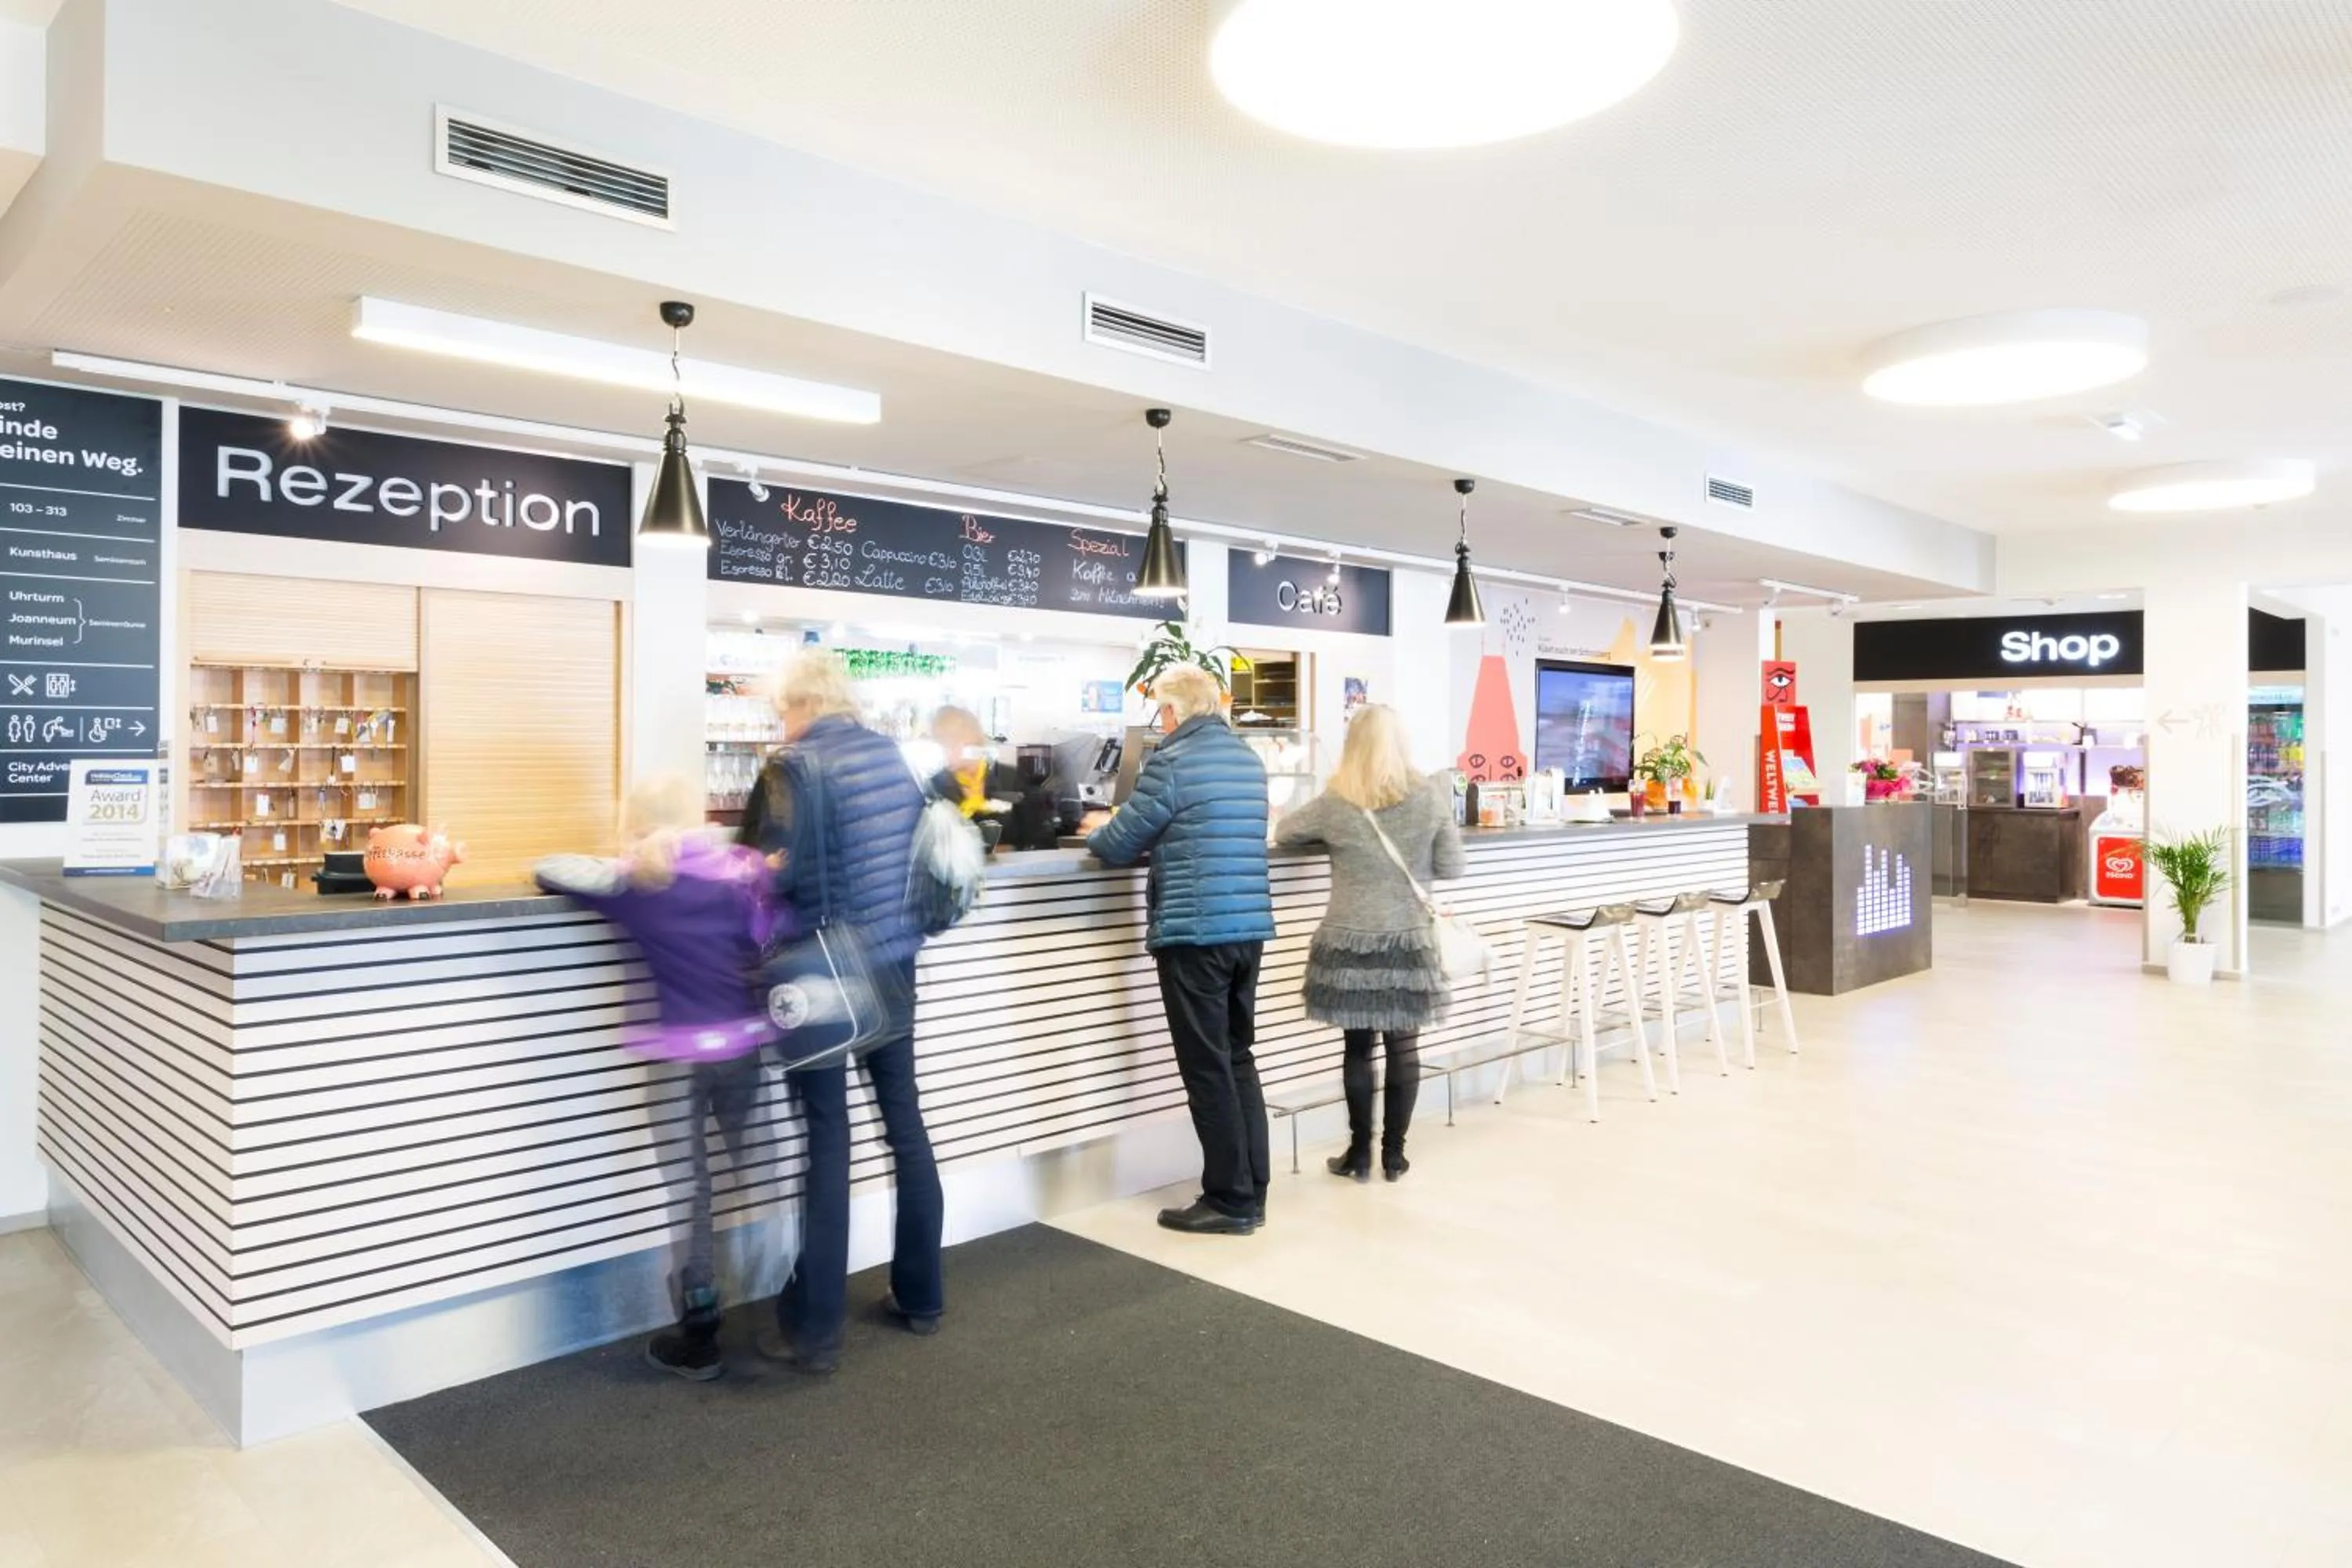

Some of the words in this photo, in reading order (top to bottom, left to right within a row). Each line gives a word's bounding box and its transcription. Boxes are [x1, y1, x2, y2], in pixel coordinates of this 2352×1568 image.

[82, 449, 143, 477] Weg.
[216, 445, 600, 537] Rezeption
[9, 503, 33, 514] 103
[45, 506, 67, 517] 313
[781, 494, 858, 533] Kaffee
[1067, 527, 1129, 557] Spezial
[9, 546, 77, 561] Kunsthaus
[9, 590, 64, 603] Uhrturm
[1277, 580, 1342, 615] Café
[9, 613, 76, 626] Joanneum
[9, 635, 64, 647] Murinsel
[2000, 630, 2120, 666] Shop
[8, 761, 35, 774] City
[8, 773, 53, 783] Center
[90, 788, 141, 802] Award
[89, 804, 139, 819] 2014
